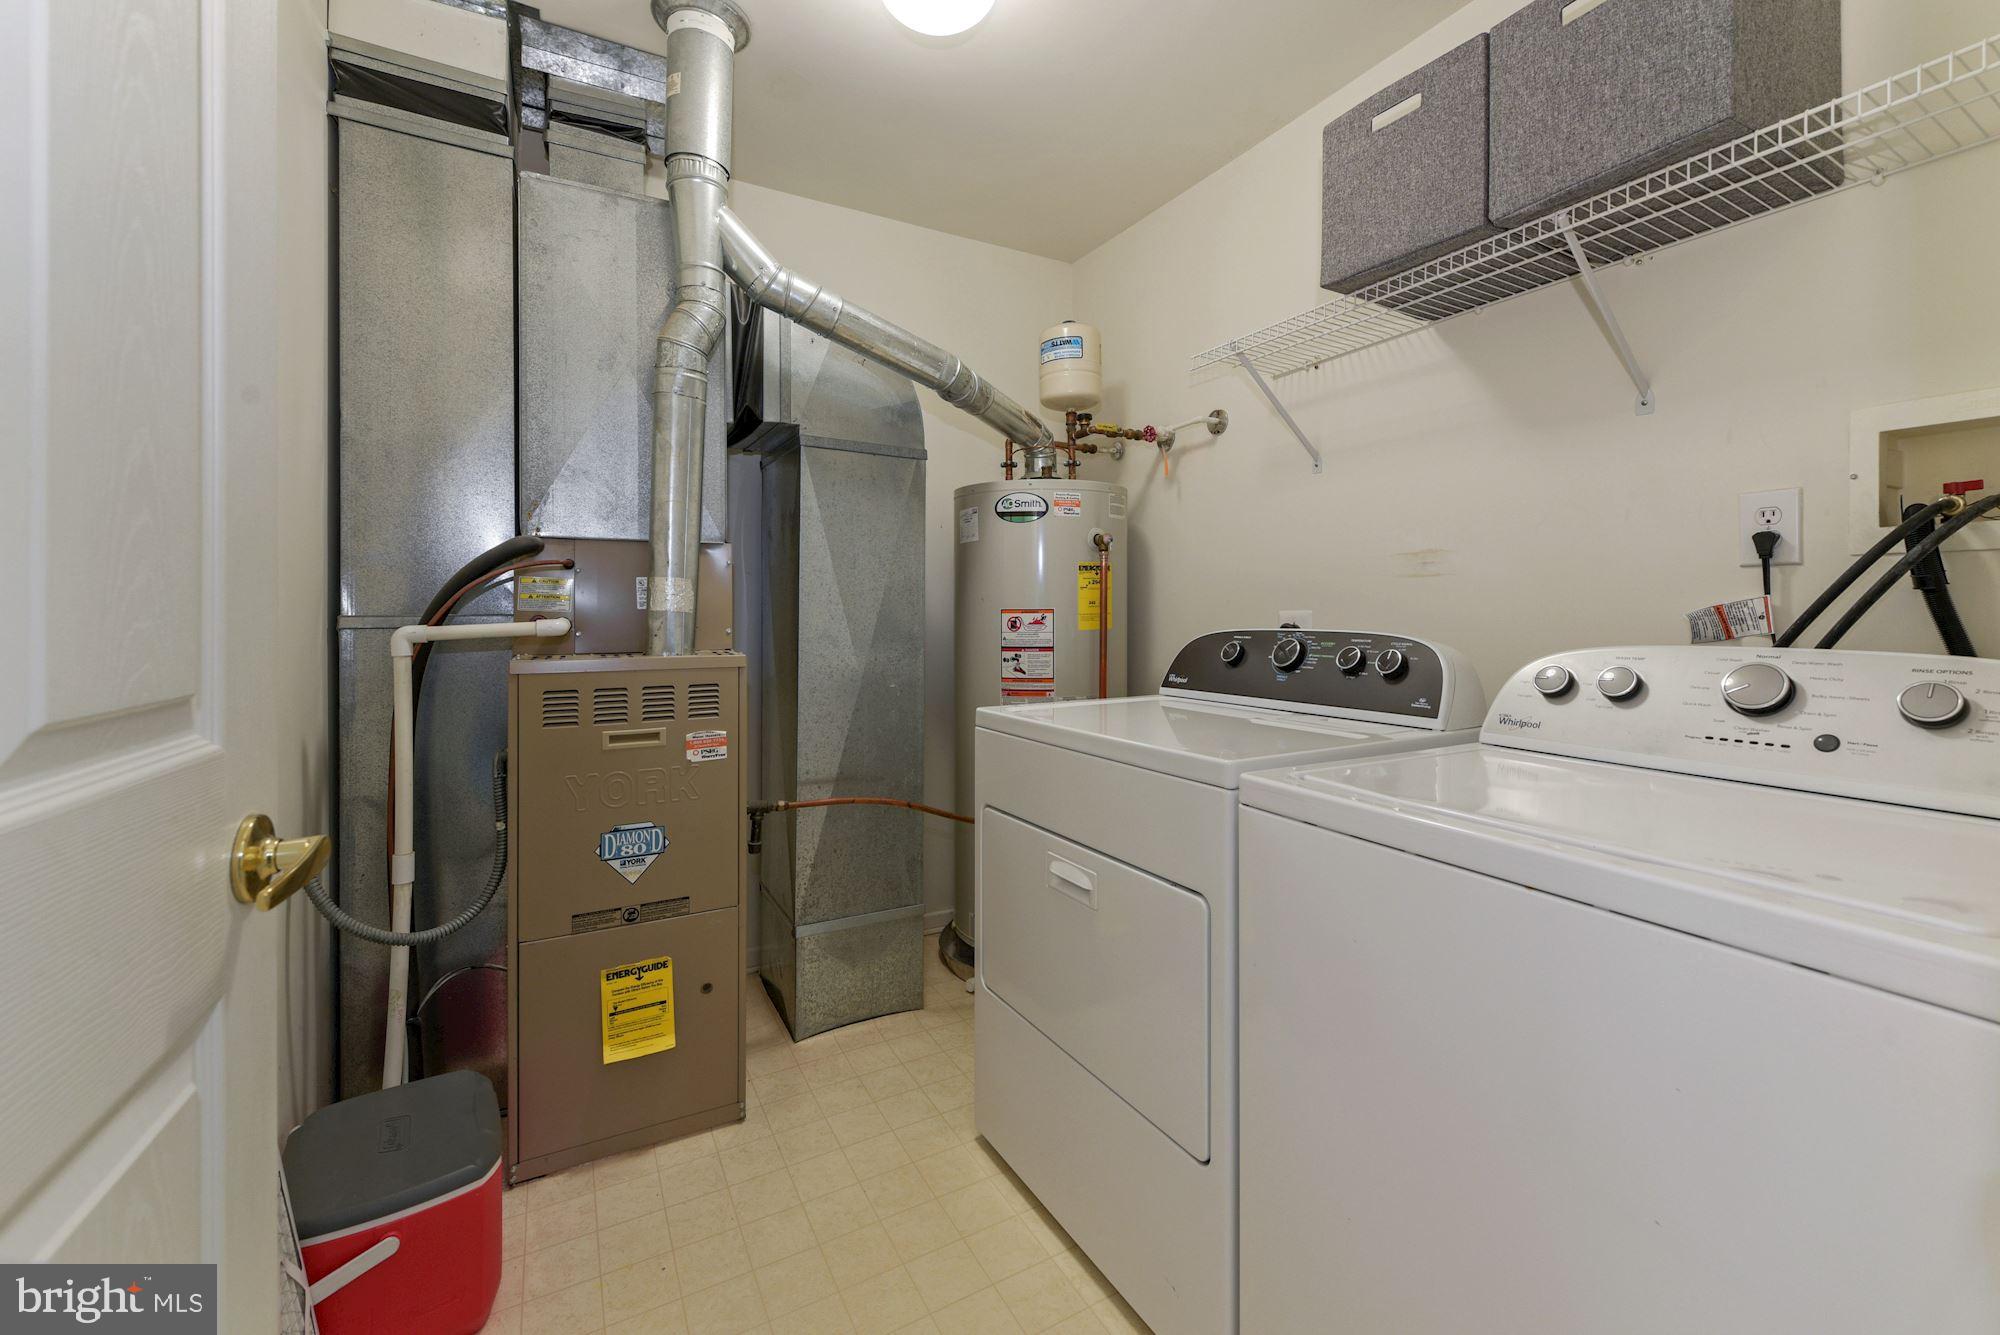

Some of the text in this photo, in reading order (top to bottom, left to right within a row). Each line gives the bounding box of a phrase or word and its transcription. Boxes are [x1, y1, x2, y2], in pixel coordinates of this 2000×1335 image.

[1499, 716, 1541, 729] Whirlpool
[562, 763, 701, 813] YORK
[604, 828, 663, 860] DIAMOND
[620, 843, 647, 857] 80
[626, 857, 647, 867] YORK
[606, 960, 669, 982] ENERGYGUIDE
